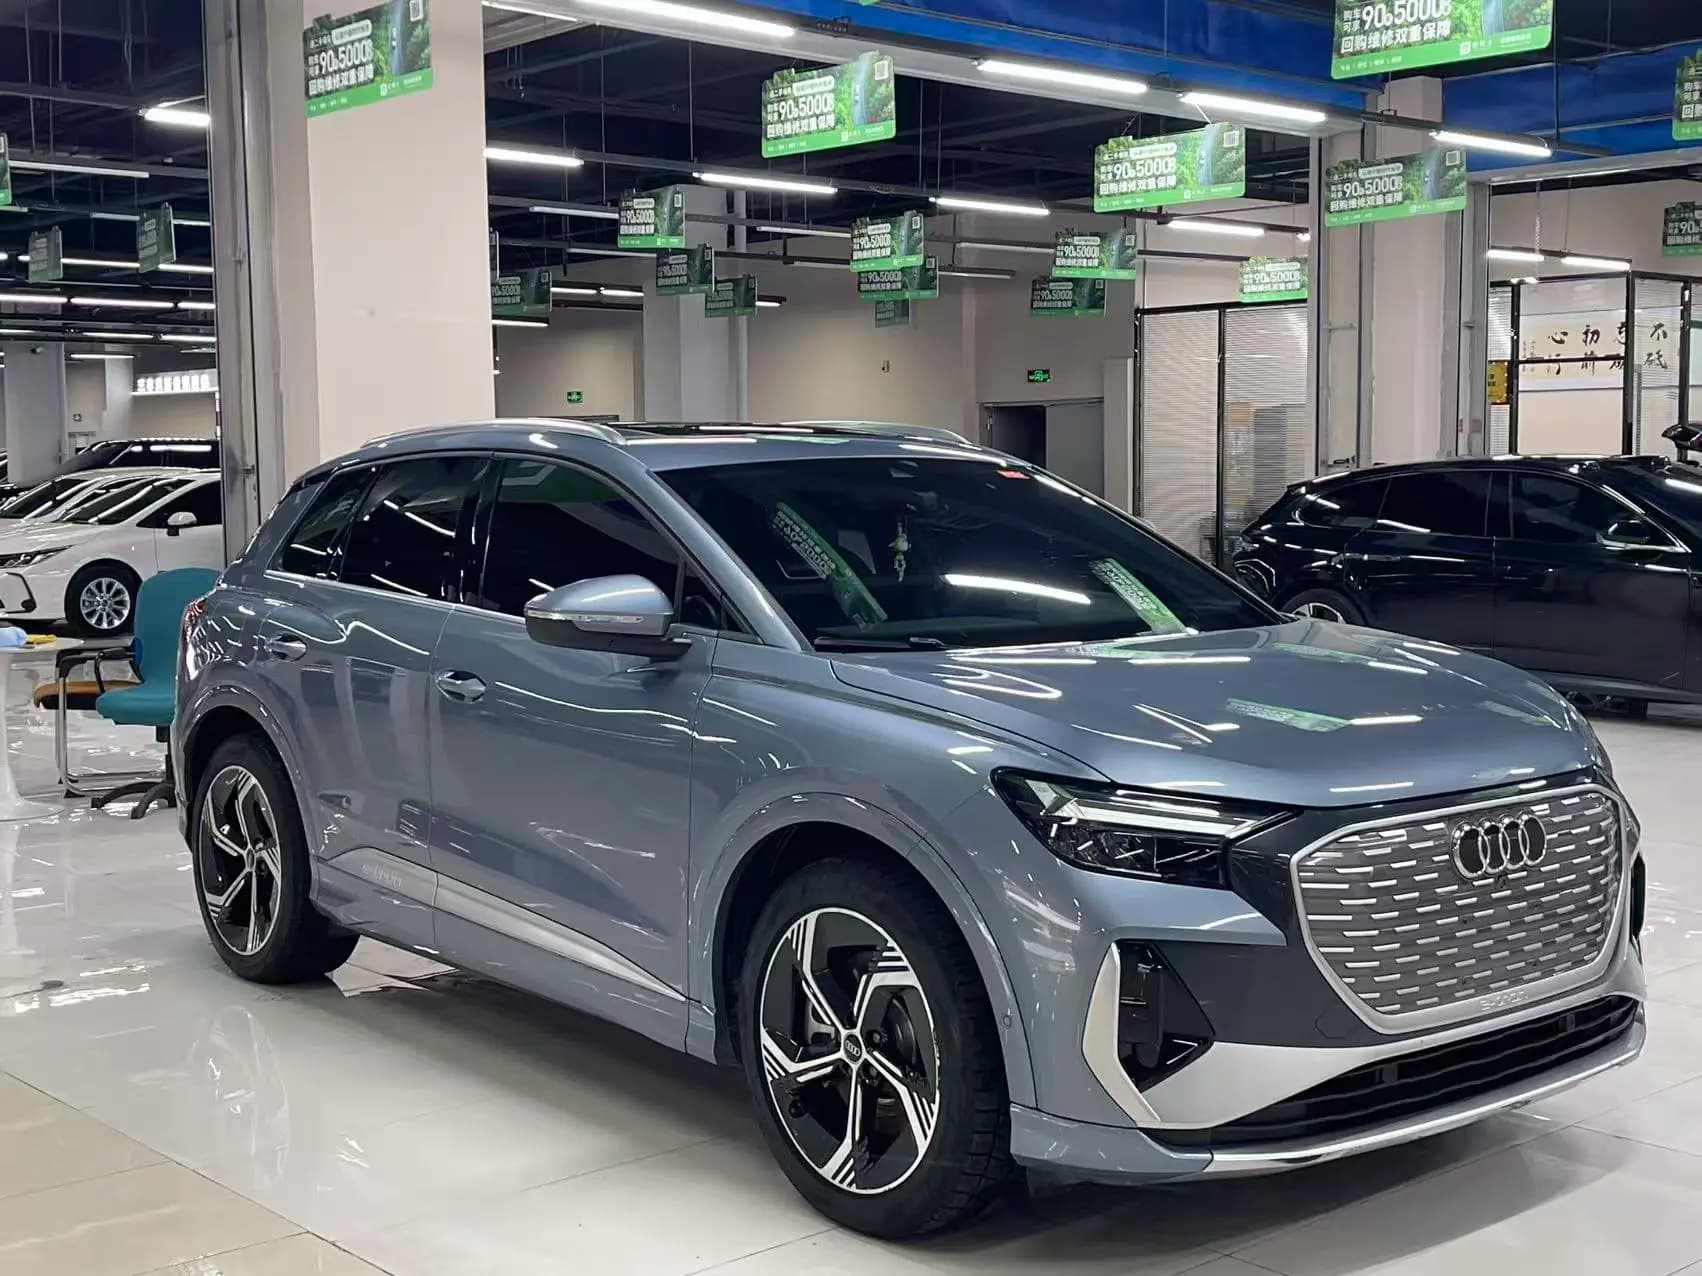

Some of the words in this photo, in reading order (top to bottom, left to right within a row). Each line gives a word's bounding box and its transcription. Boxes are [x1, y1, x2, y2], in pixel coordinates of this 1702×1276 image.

[1340, 19, 1452, 54] 回购维修双重保障
